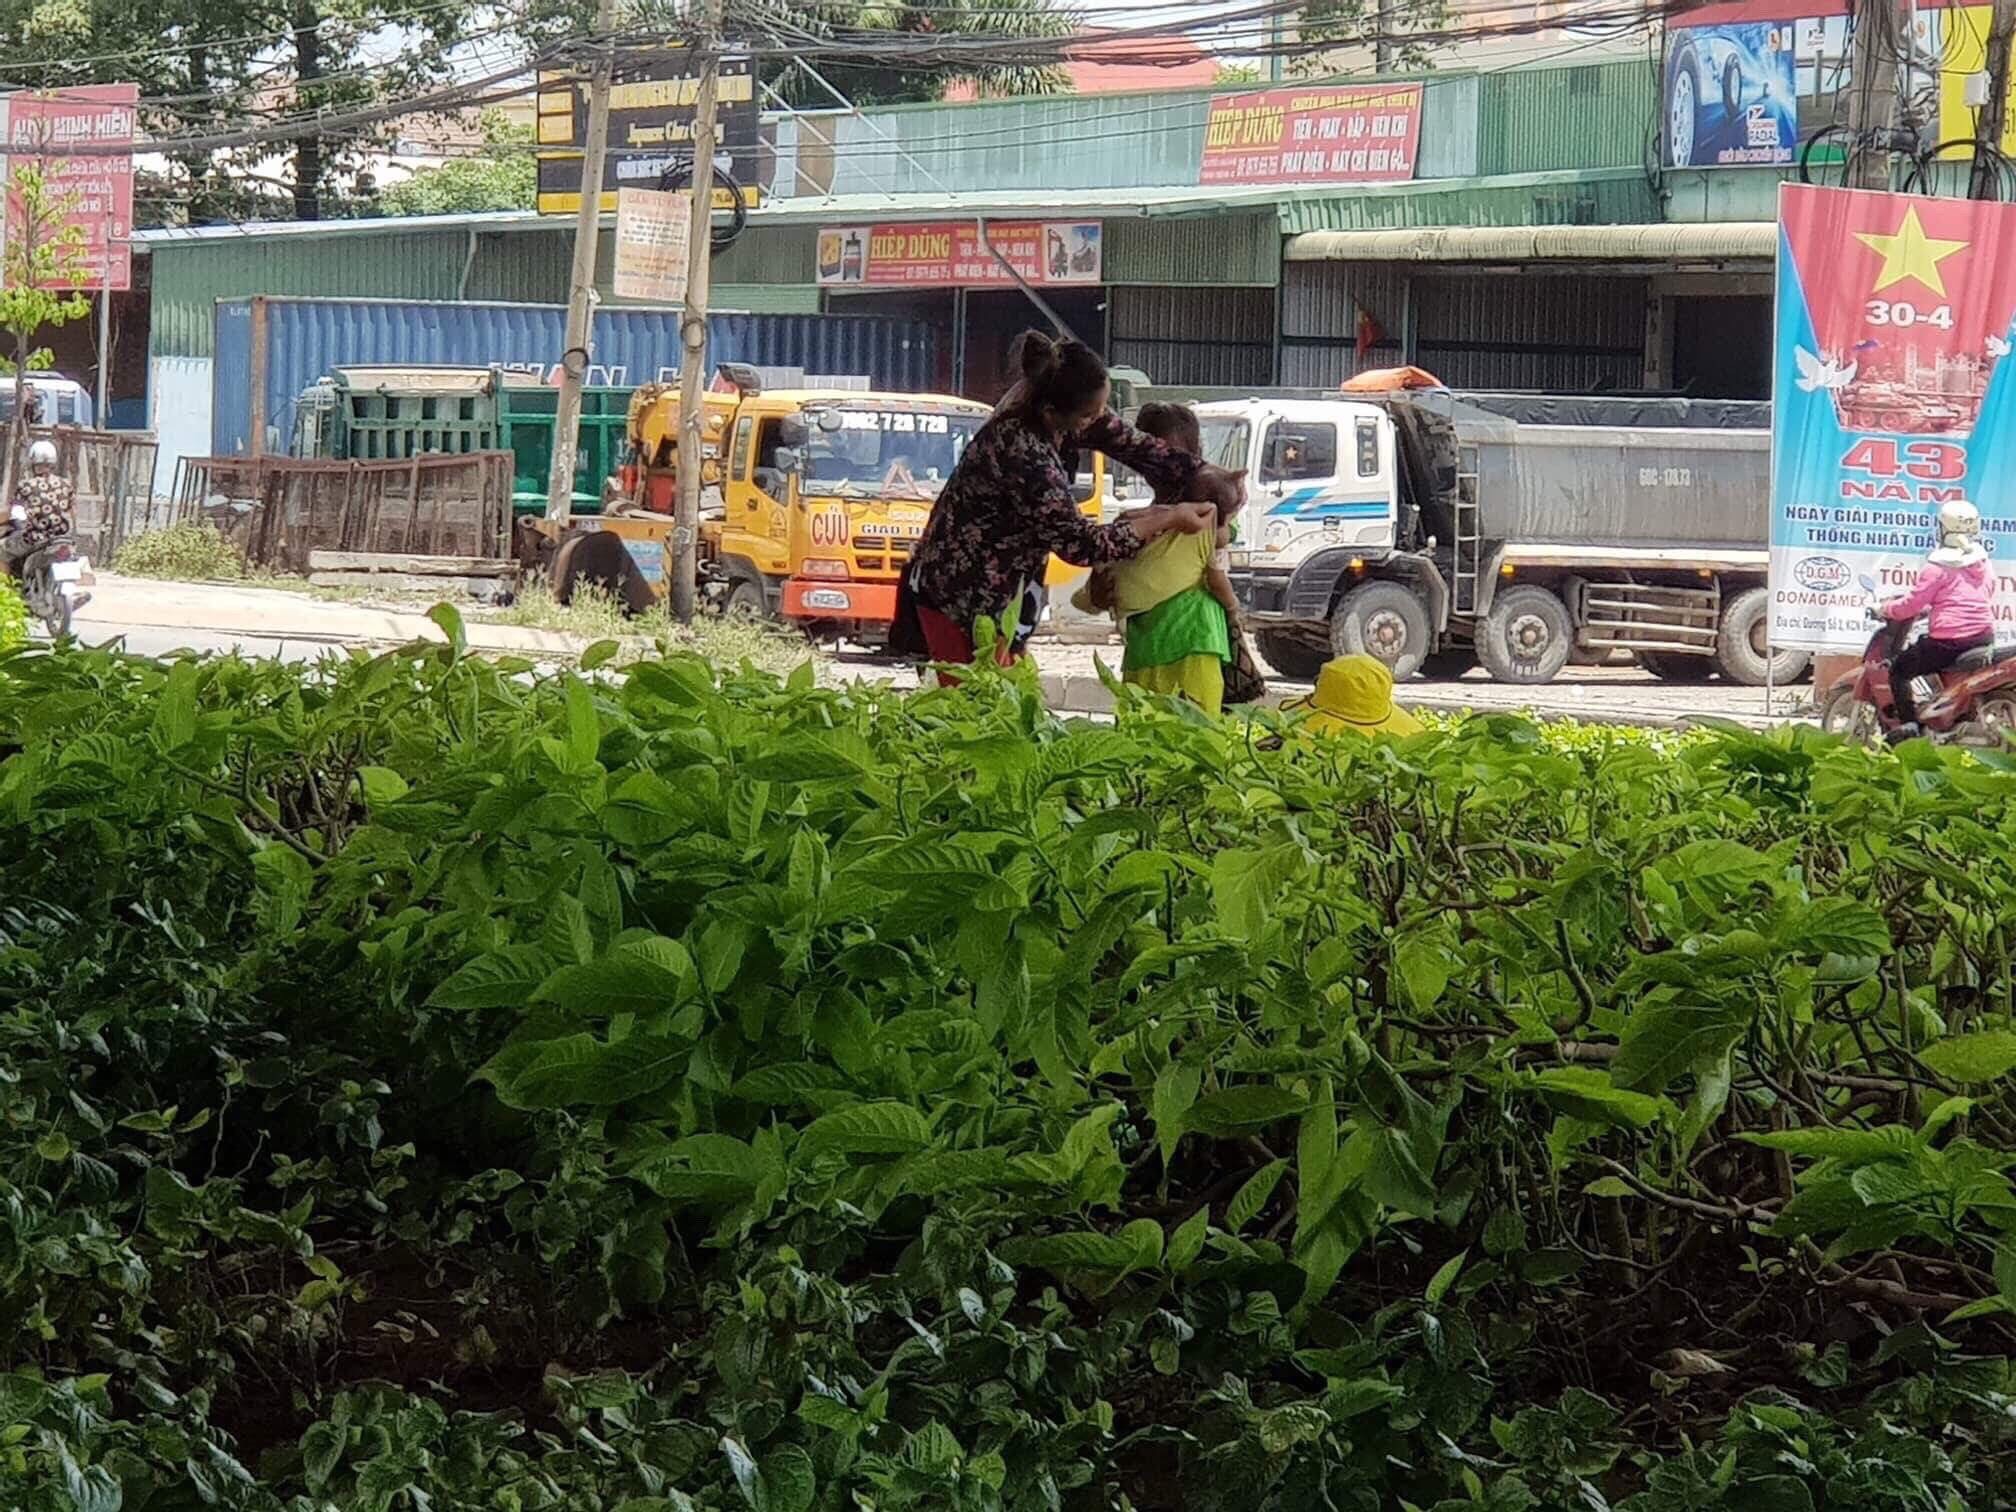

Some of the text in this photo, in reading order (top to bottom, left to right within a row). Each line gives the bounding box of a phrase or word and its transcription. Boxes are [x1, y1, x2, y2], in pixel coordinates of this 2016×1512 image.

[1864, 299, 1954, 331] 30-4
[1840, 437, 1968, 481] 43
[1879, 562, 1918, 587] TỔN
[1775, 589, 1867, 609] DONAGAMEX
